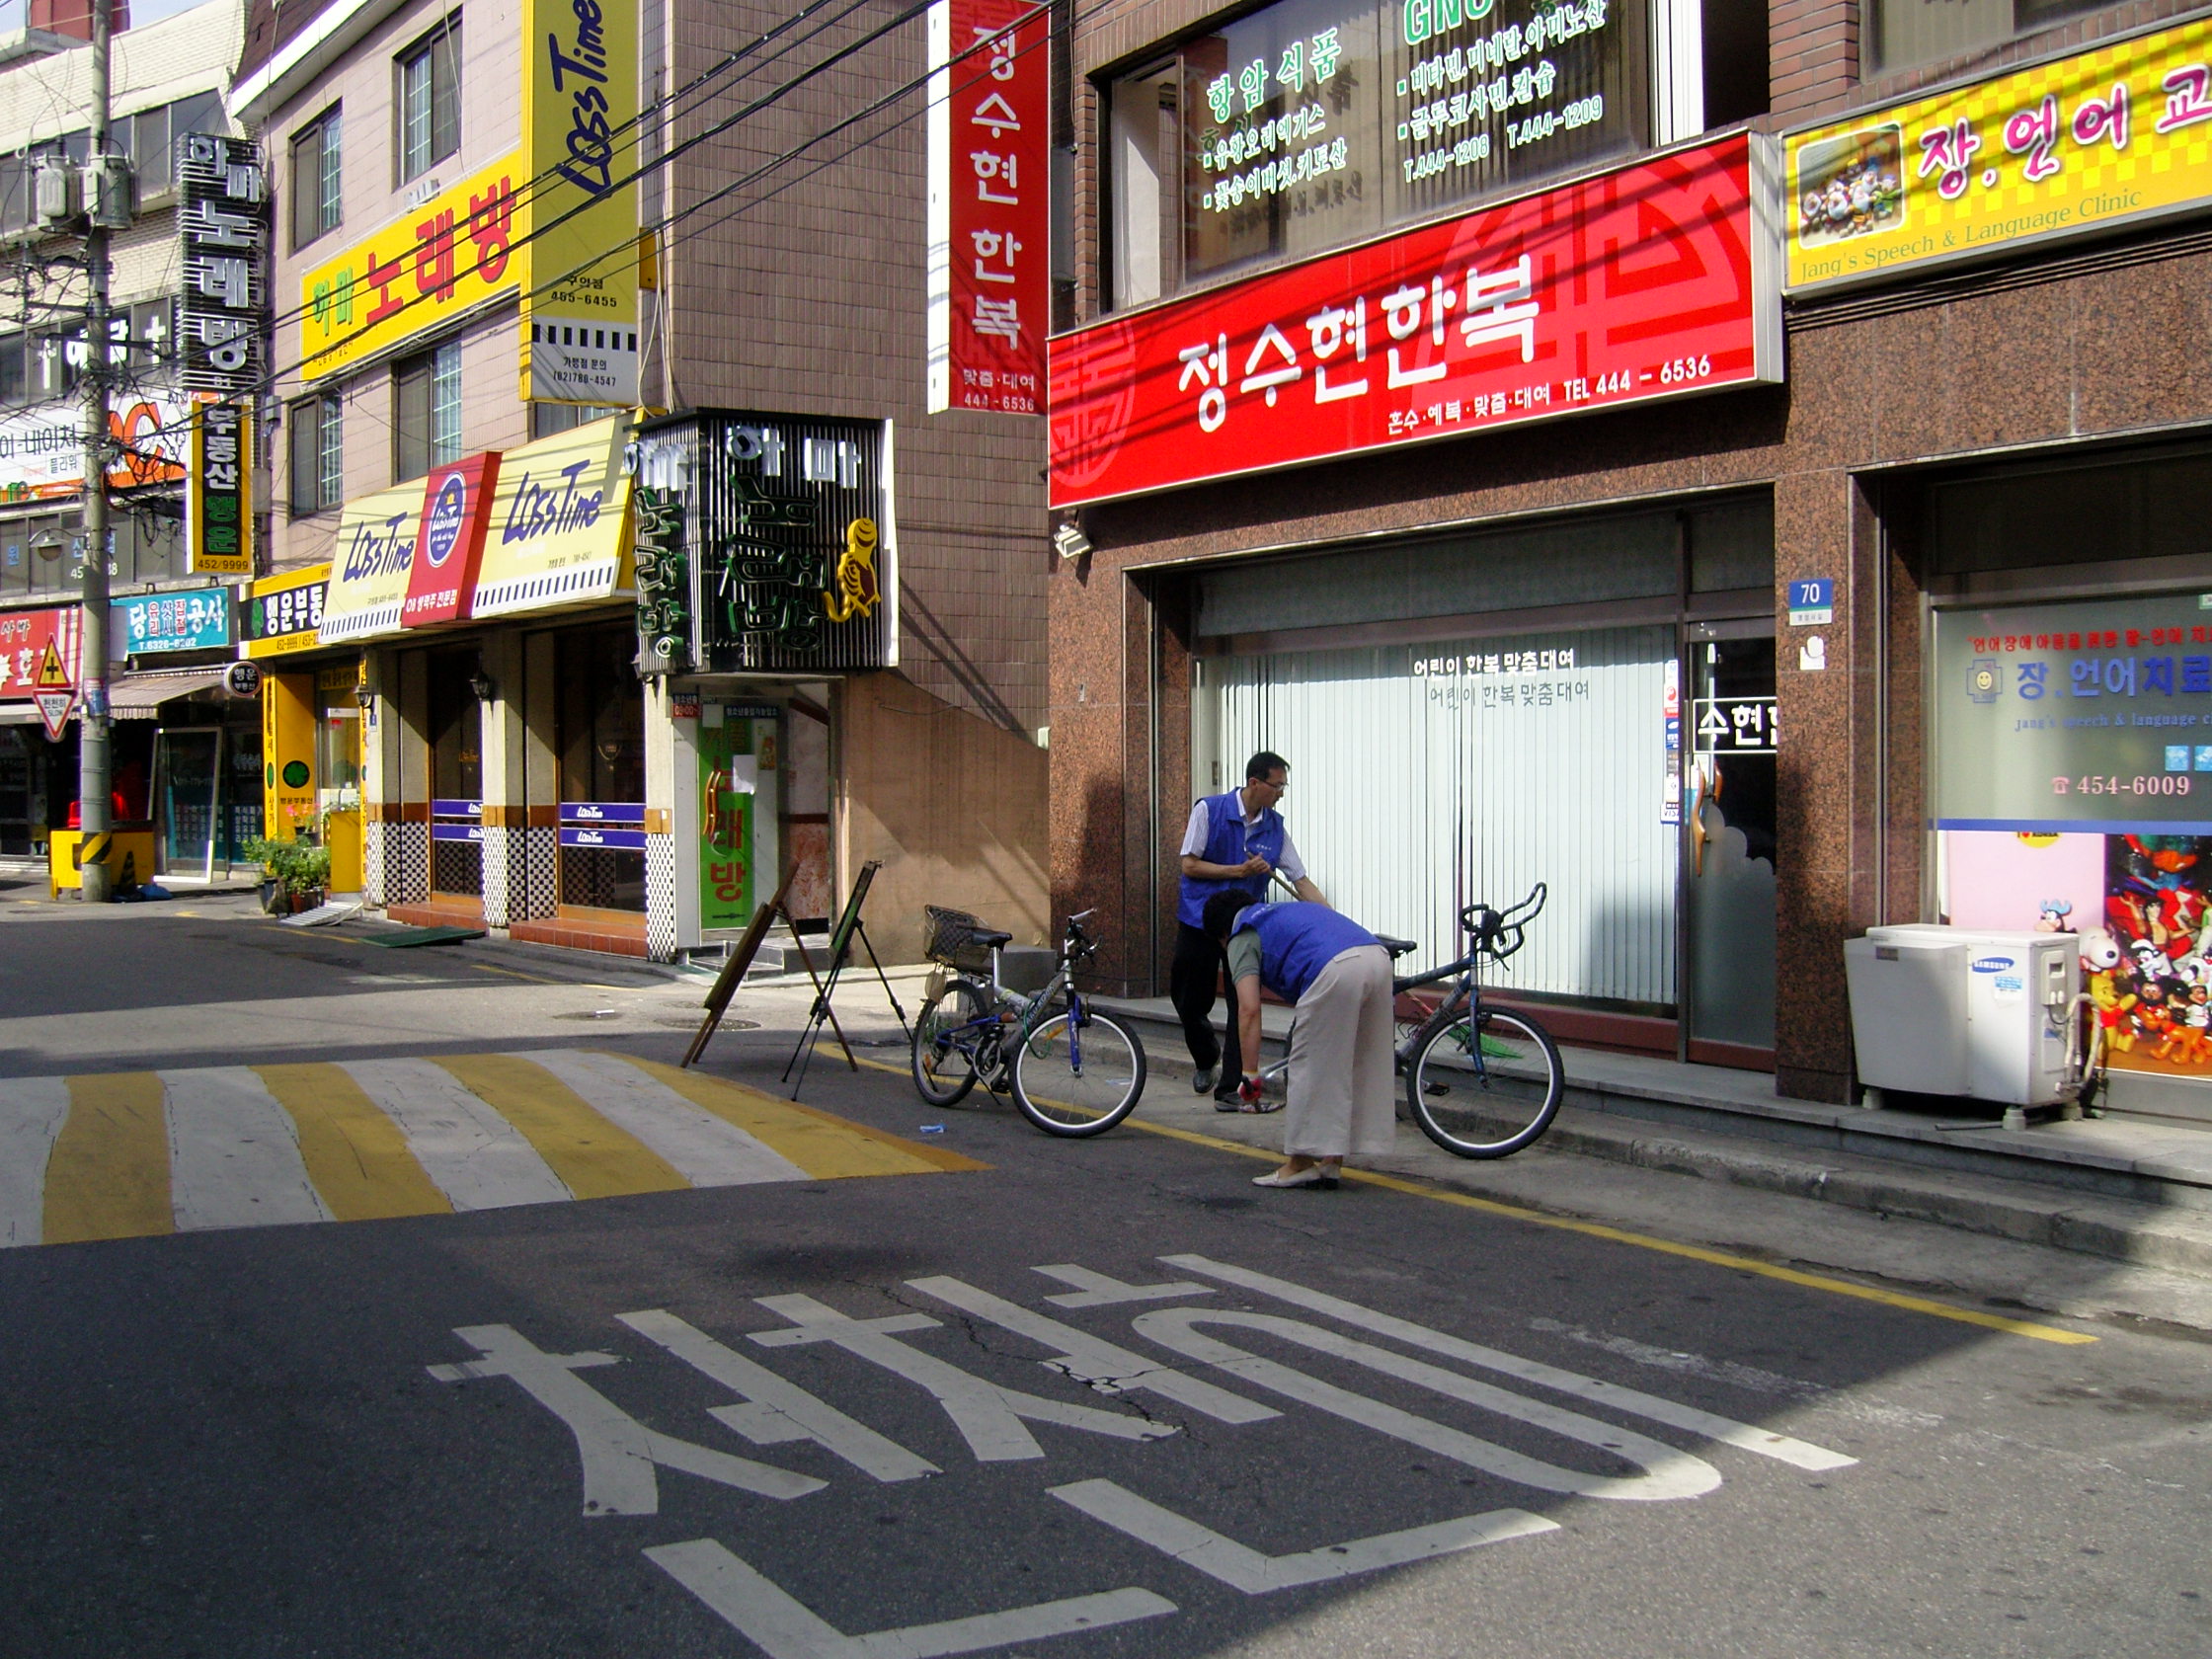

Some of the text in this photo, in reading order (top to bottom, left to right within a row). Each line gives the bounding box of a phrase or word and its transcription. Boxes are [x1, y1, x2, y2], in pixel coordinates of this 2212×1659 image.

[1507, 94, 1604, 149] T.444-1209
[1403, 134, 1490, 184] T.444-1208
[366, 175, 516, 327] 노래방
[1800, 190, 2143, 283] Jang's Speech & Language Clinic
[198, 200, 250, 370] 노래방
[1177, 253, 1541, 434] 정수현한복
[1563, 377, 1591, 403] TEL
[727, 425, 862, 489] 하마
[204, 496, 238, 554] 행운
[187, 594, 225, 633] 공사
[1800, 583, 1821, 604] 70
[1413, 660, 1462, 681] 어린이
[1465, 654, 1500, 679] 한복
[2132, 711, 2197, 730] language
[2076, 775, 2190, 797] 454-6009
